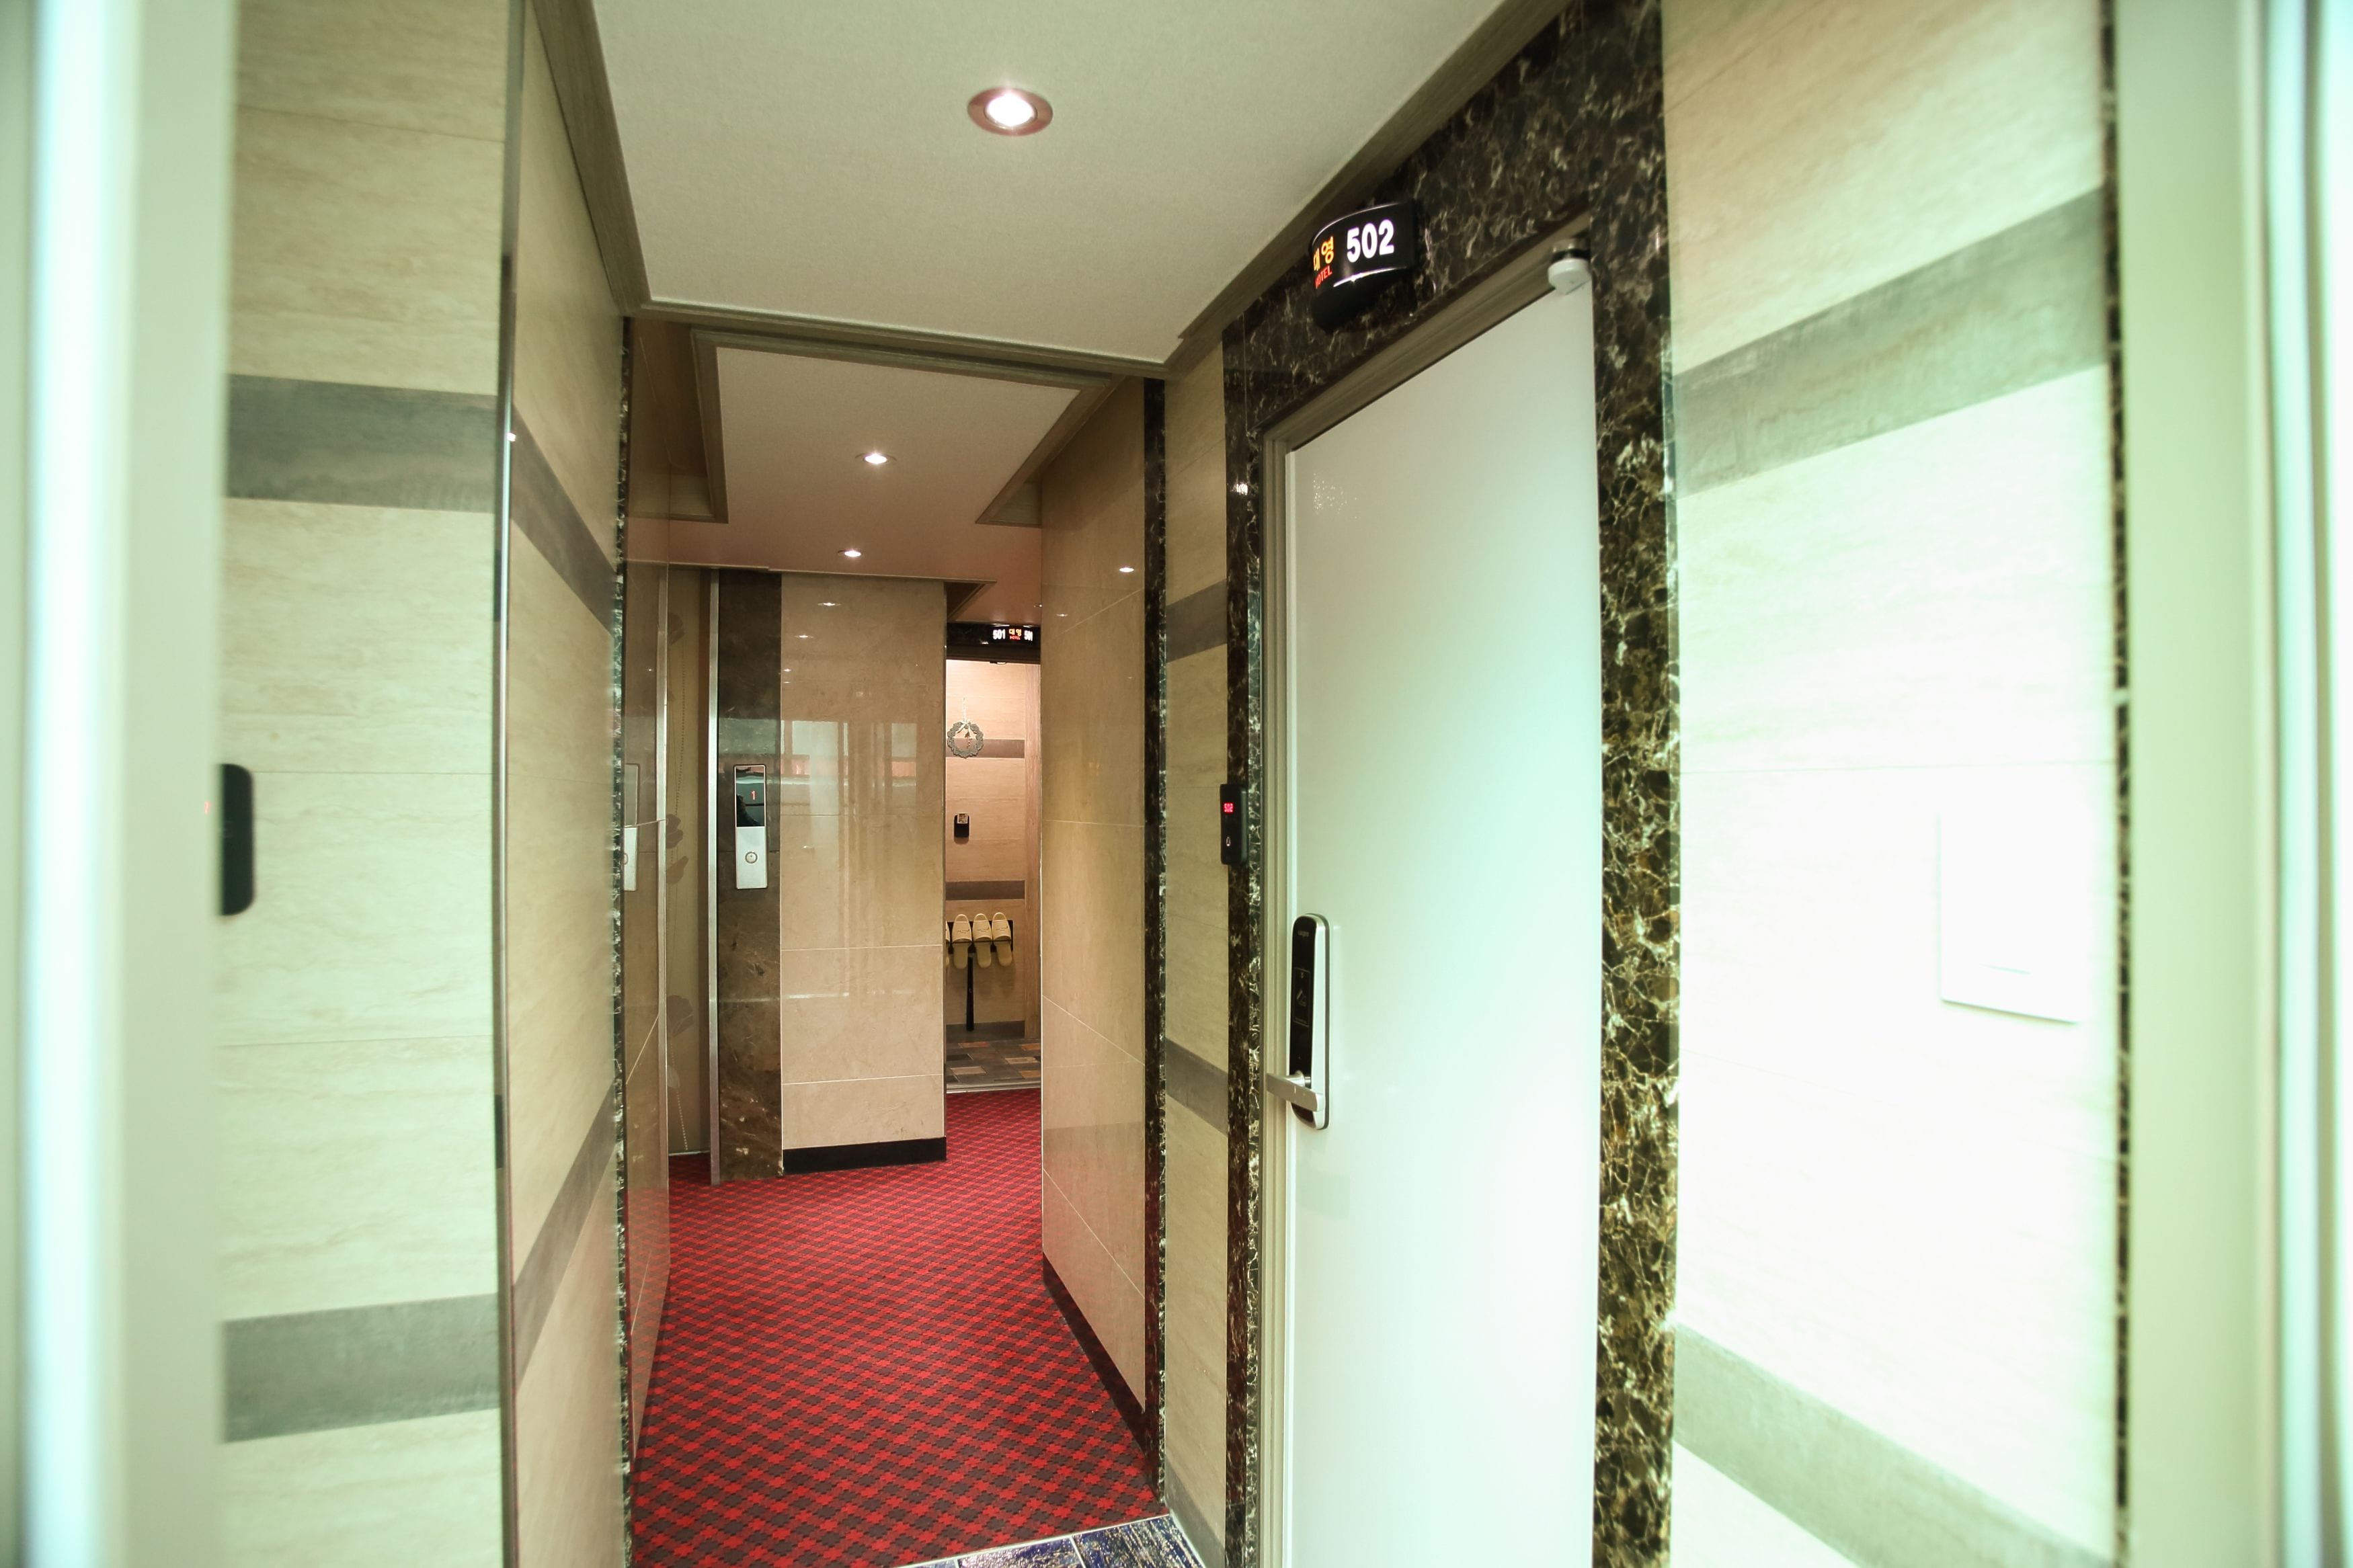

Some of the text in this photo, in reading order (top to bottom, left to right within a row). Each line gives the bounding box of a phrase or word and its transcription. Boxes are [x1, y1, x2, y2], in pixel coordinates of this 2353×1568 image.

[1347, 219, 1395, 263] 502
[993, 629, 1006, 640] 501
[1009, 628, 1022, 636] 대영
[1024, 630, 1033, 641] 501
[751, 790, 756, 800] 1
